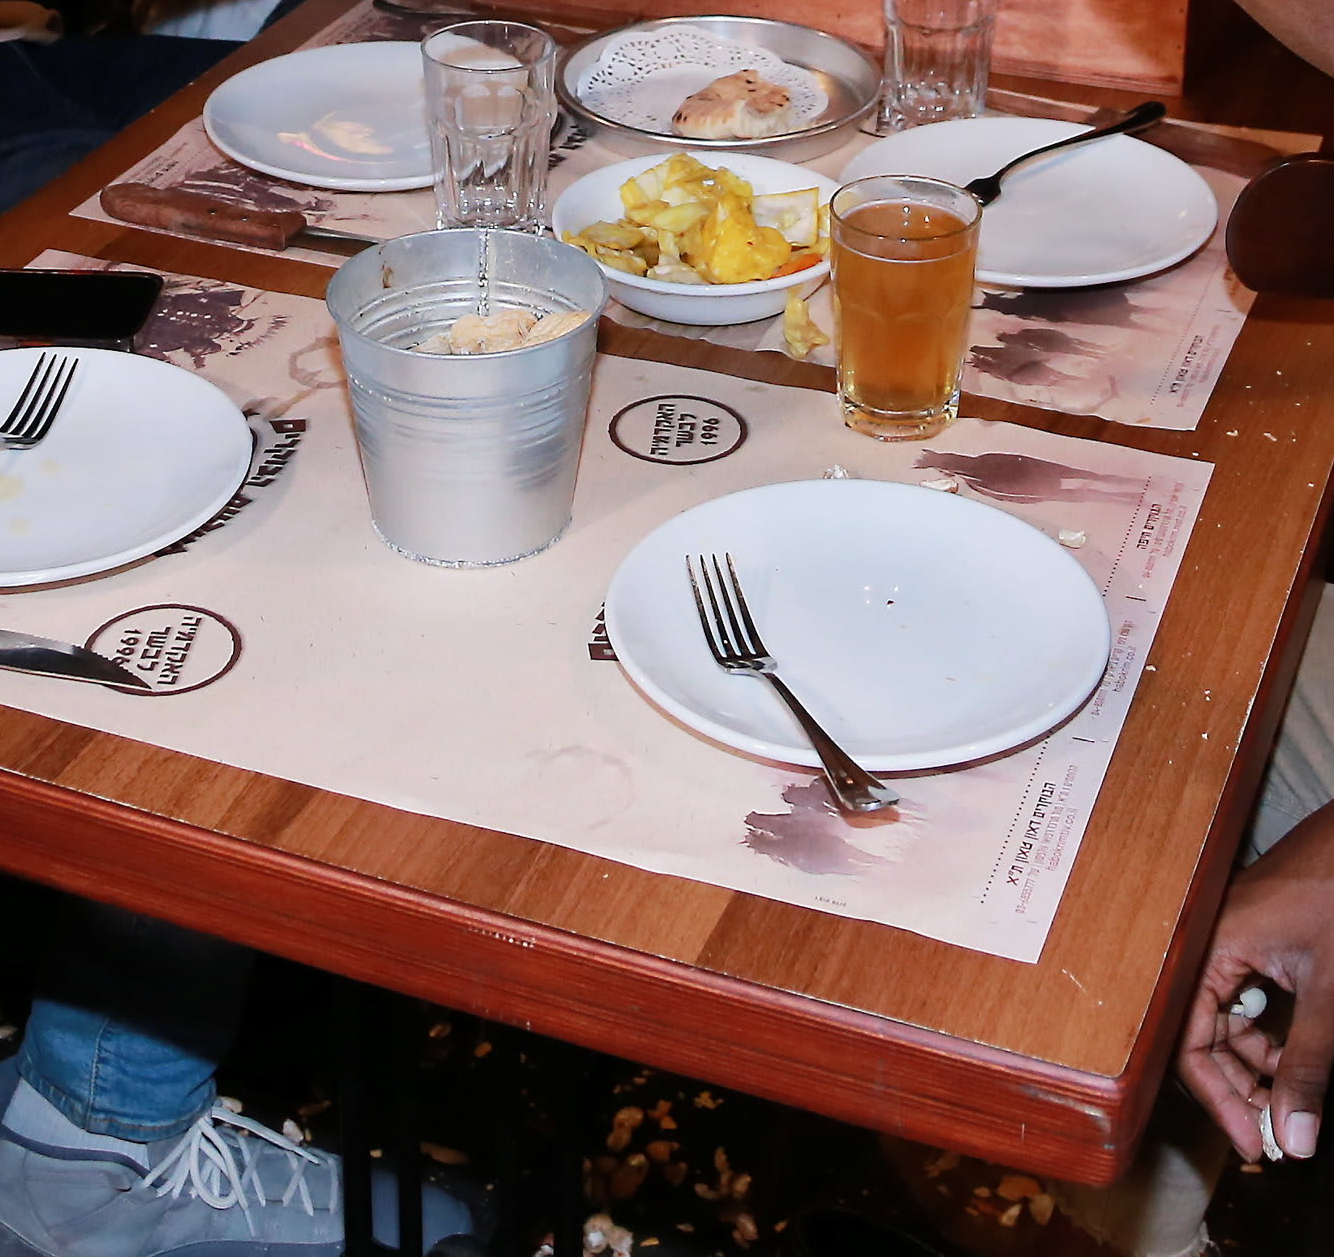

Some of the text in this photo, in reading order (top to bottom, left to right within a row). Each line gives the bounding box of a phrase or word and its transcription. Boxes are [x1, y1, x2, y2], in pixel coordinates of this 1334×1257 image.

[650, 403, 675, 455] האקדמיה
[675, 413, 697, 447] לבשר
[700, 418, 720, 445] 1996
[112, 629, 142, 666] 1996
[137, 627, 171, 671] לבשר
[157, 616, 203, 684] האקדמיה
[1033, 782, 1056, 819] הבוקרים
[1024, 820, 1041, 841] דאון
[1015, 841, 1033, 864] טאון
